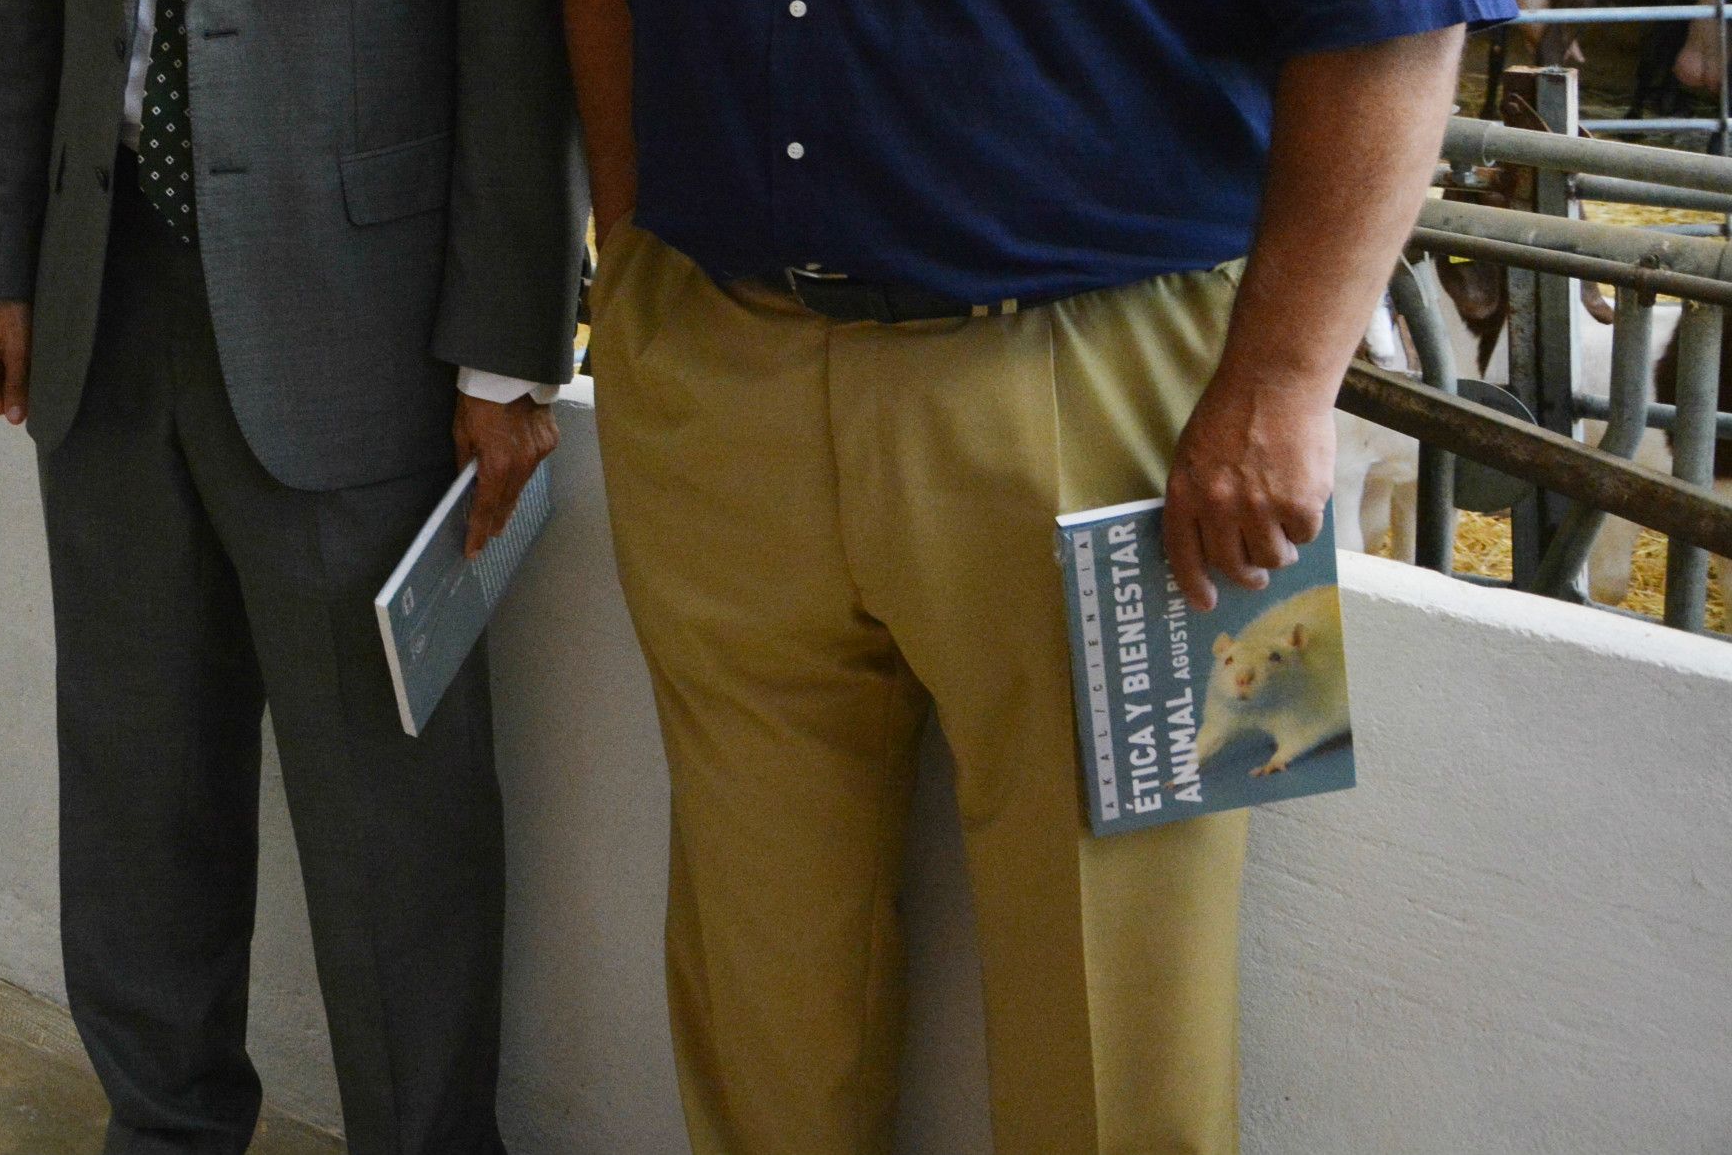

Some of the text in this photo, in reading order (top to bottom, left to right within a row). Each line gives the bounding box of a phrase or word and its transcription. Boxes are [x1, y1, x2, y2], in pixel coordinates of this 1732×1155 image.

[1108, 521, 1162, 814] ÉTICA Y BIENESTAR
[1163, 597, 1191, 680] AGUSTÍN
[1165, 686, 1203, 803] ANIMAL
